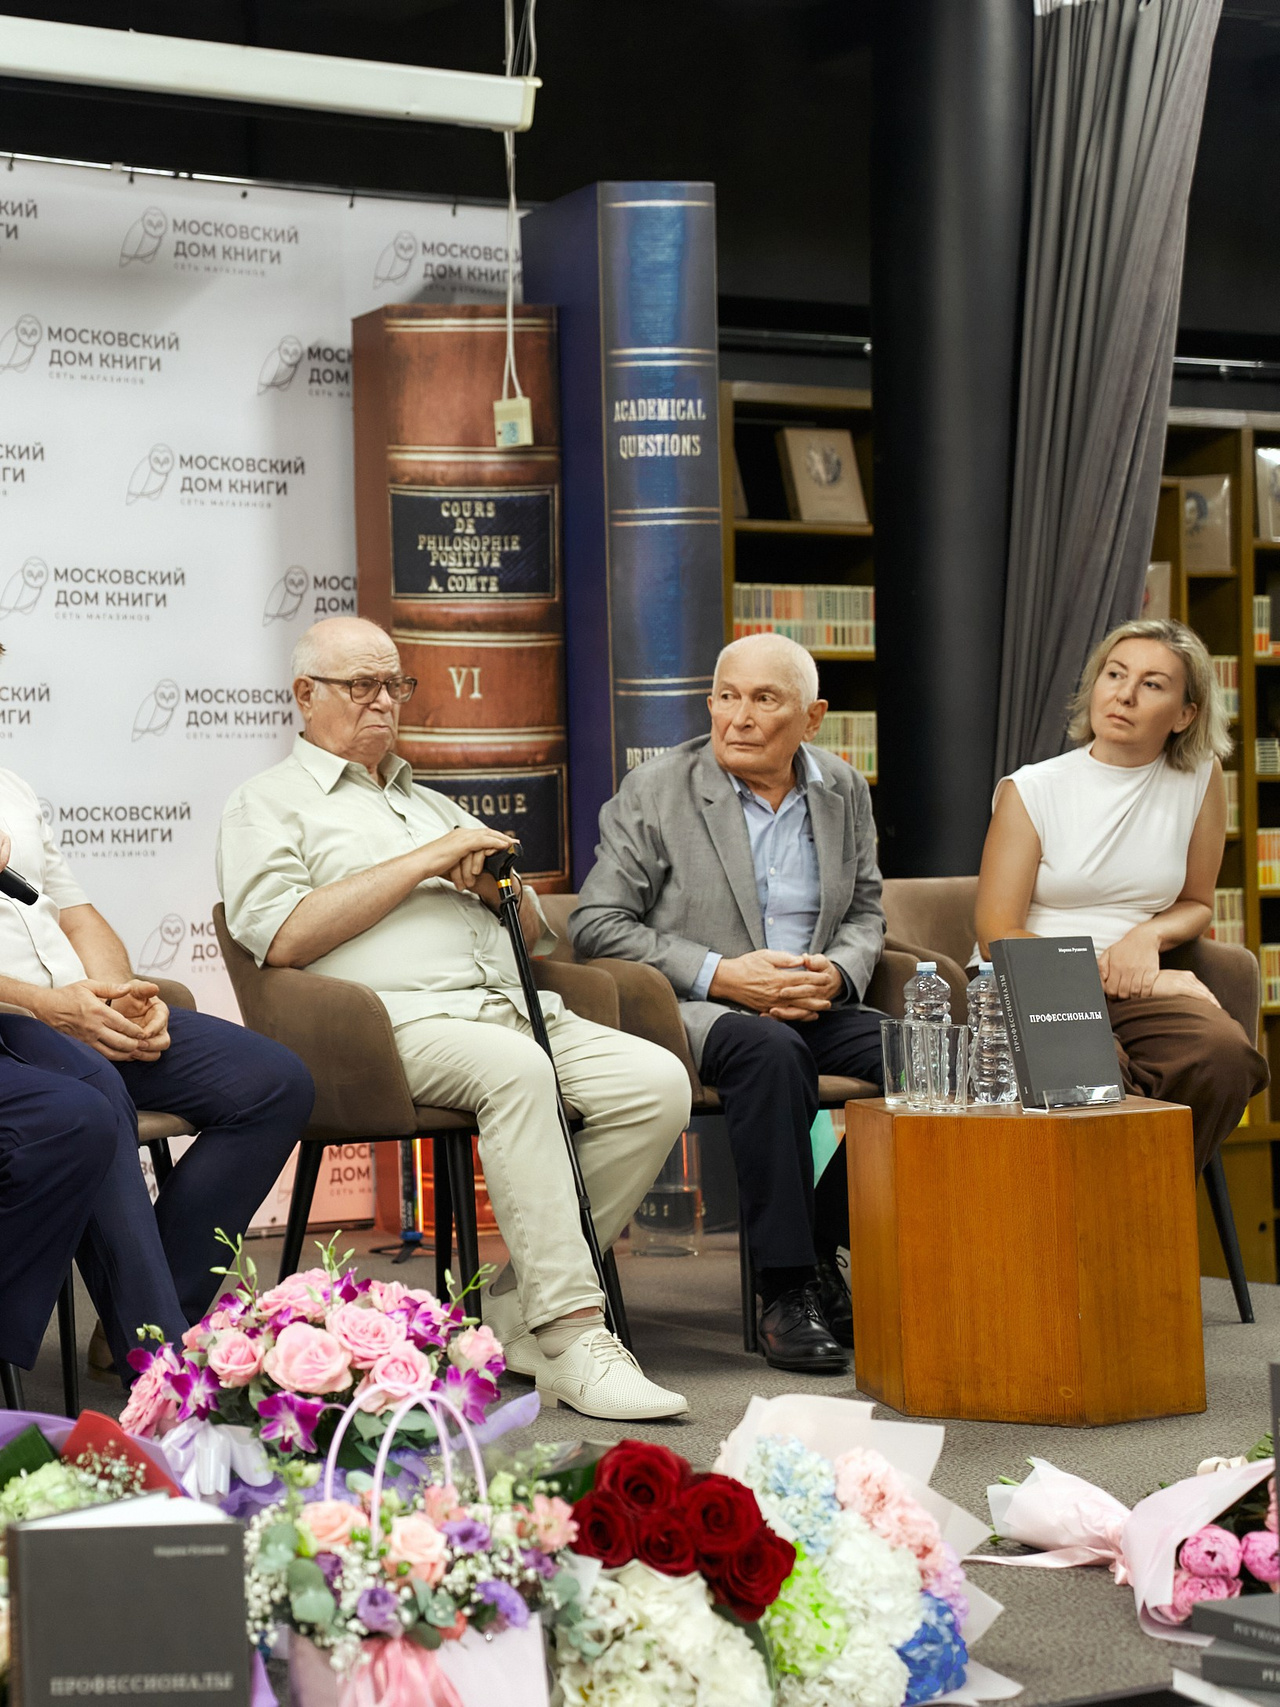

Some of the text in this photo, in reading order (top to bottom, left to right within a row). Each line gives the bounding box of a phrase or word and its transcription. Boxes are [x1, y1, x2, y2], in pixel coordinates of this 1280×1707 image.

[172, 218, 299, 244] МОСКОВСКИЙ
[174, 240, 281, 265] ДОМ КНИГИ
[423, 262, 462, 280] ДОМ
[48, 326, 179, 351] МОСКОВСКИЙ
[49, 349, 161, 372] ДОМ КНИГИ
[308, 367, 349, 386] ДОМ
[614, 398, 707, 423] ACADEMICAL
[619, 433, 701, 459] QUESTIONS
[179, 454, 305, 475] МОСКОВСКИЙ
[180, 476, 287, 496] ДОМ КНИГИ
[441, 501, 496, 518] COURS
[453, 518, 476, 534] DE
[417, 534, 521, 551] PHILOSOPHIE
[430, 551, 502, 568] POSITIVE
[54, 567, 185, 586] МОСКОВСКИЙ
[428, 575, 499, 592] A. COMTE
[55, 590, 167, 608] ДОМ КНИГИ
[314, 597, 354, 614] ДОМ
[448, 667, 482, 699] VI
[186, 710, 293, 728] ДОМ КНИГИ
[59, 802, 191, 823] МОСКОВСКИЙ
[60, 828, 172, 847] ДОМ КНИГИ
[1029, 1011, 1102, 1023] ПРОФЕССИОНАЛЫ
[330, 1166, 370, 1185] ДОМ
[50, 1672, 234, 1697] ПРОФЕССИОНАЛЫ
